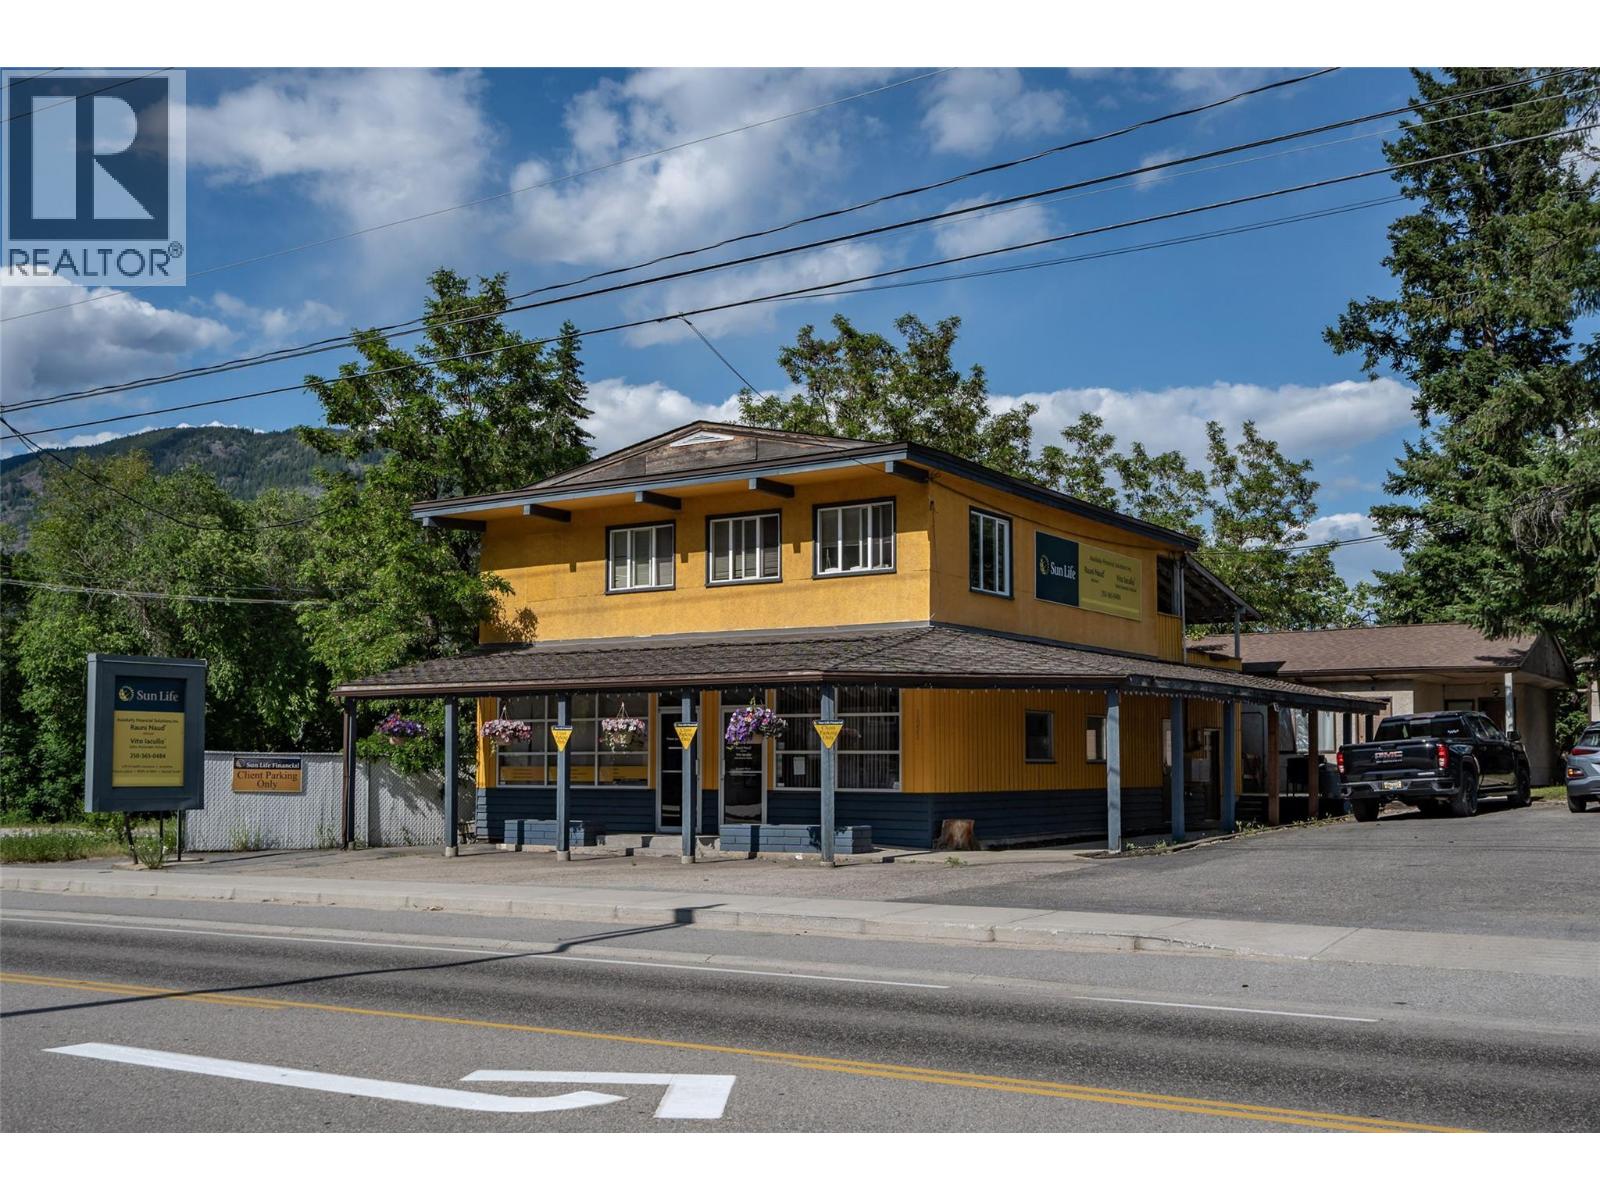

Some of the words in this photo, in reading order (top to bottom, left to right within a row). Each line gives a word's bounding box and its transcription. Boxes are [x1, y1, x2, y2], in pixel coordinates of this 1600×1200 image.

[1050, 561, 1064, 577] Sun
[1064, 565, 1077, 580] Life
[136, 690, 157, 701] Sun
[159, 691, 179, 702] Life
[1374, 751, 1403, 759] GMC
[237, 771, 263, 780] Client
[265, 771, 298, 781] Parking
[256, 779, 277, 790] Only
